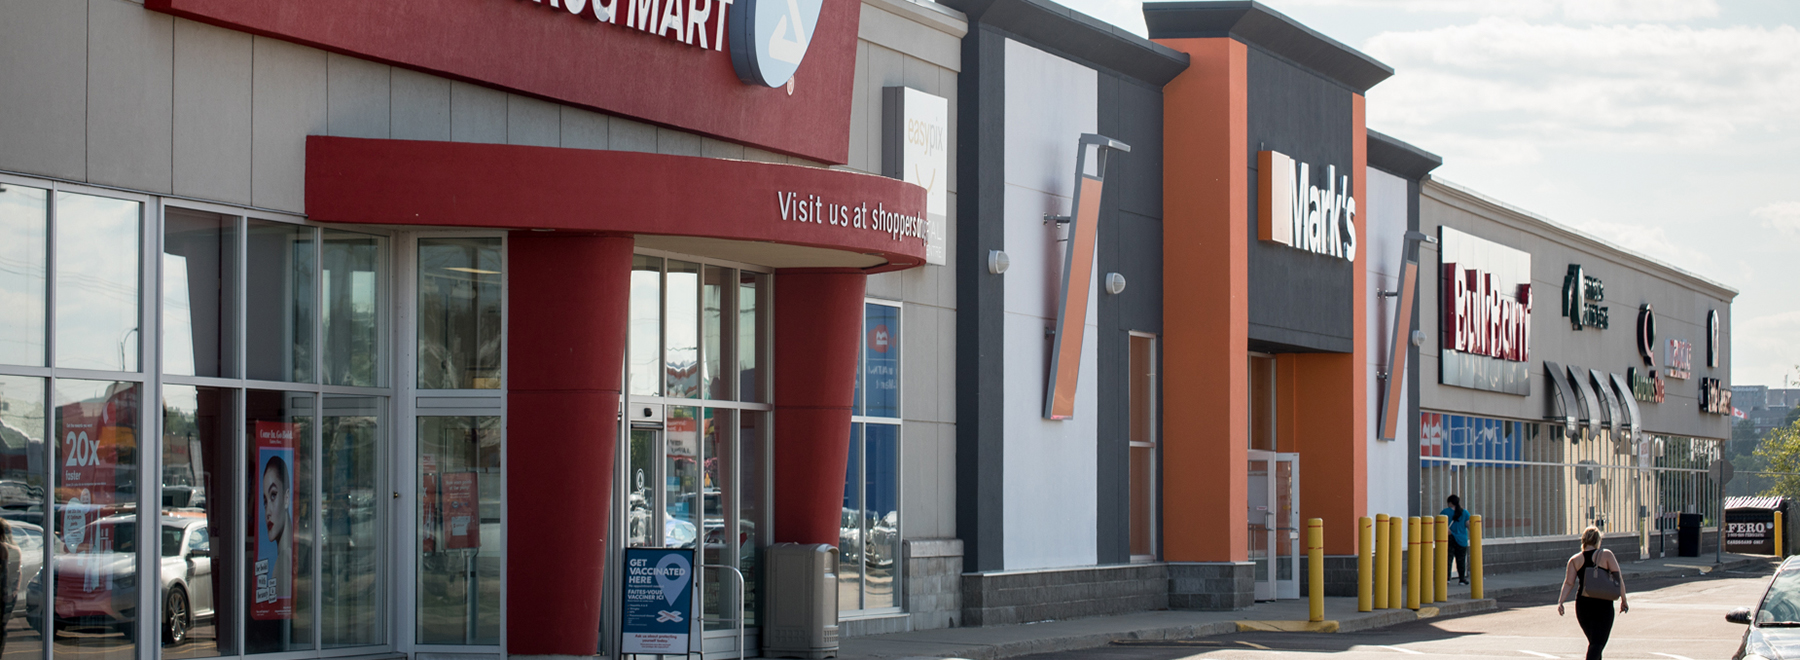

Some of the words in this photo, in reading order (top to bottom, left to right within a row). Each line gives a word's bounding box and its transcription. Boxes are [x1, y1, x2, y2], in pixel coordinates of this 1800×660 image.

[626, 0, 734, 52] MART
[908, 117, 944, 157] easypix
[777, 191, 822, 224] Visit
[829, 203, 848, 227] us
[853, 202, 867, 229] at
[1288, 158, 1357, 262] Mark's
[65, 431, 101, 467] 20x
[65, 470, 81, 481] faster
[628, 576, 652, 584] HERE
[629, 558, 647, 567] GET
[629, 567, 686, 576] VACCINATED
